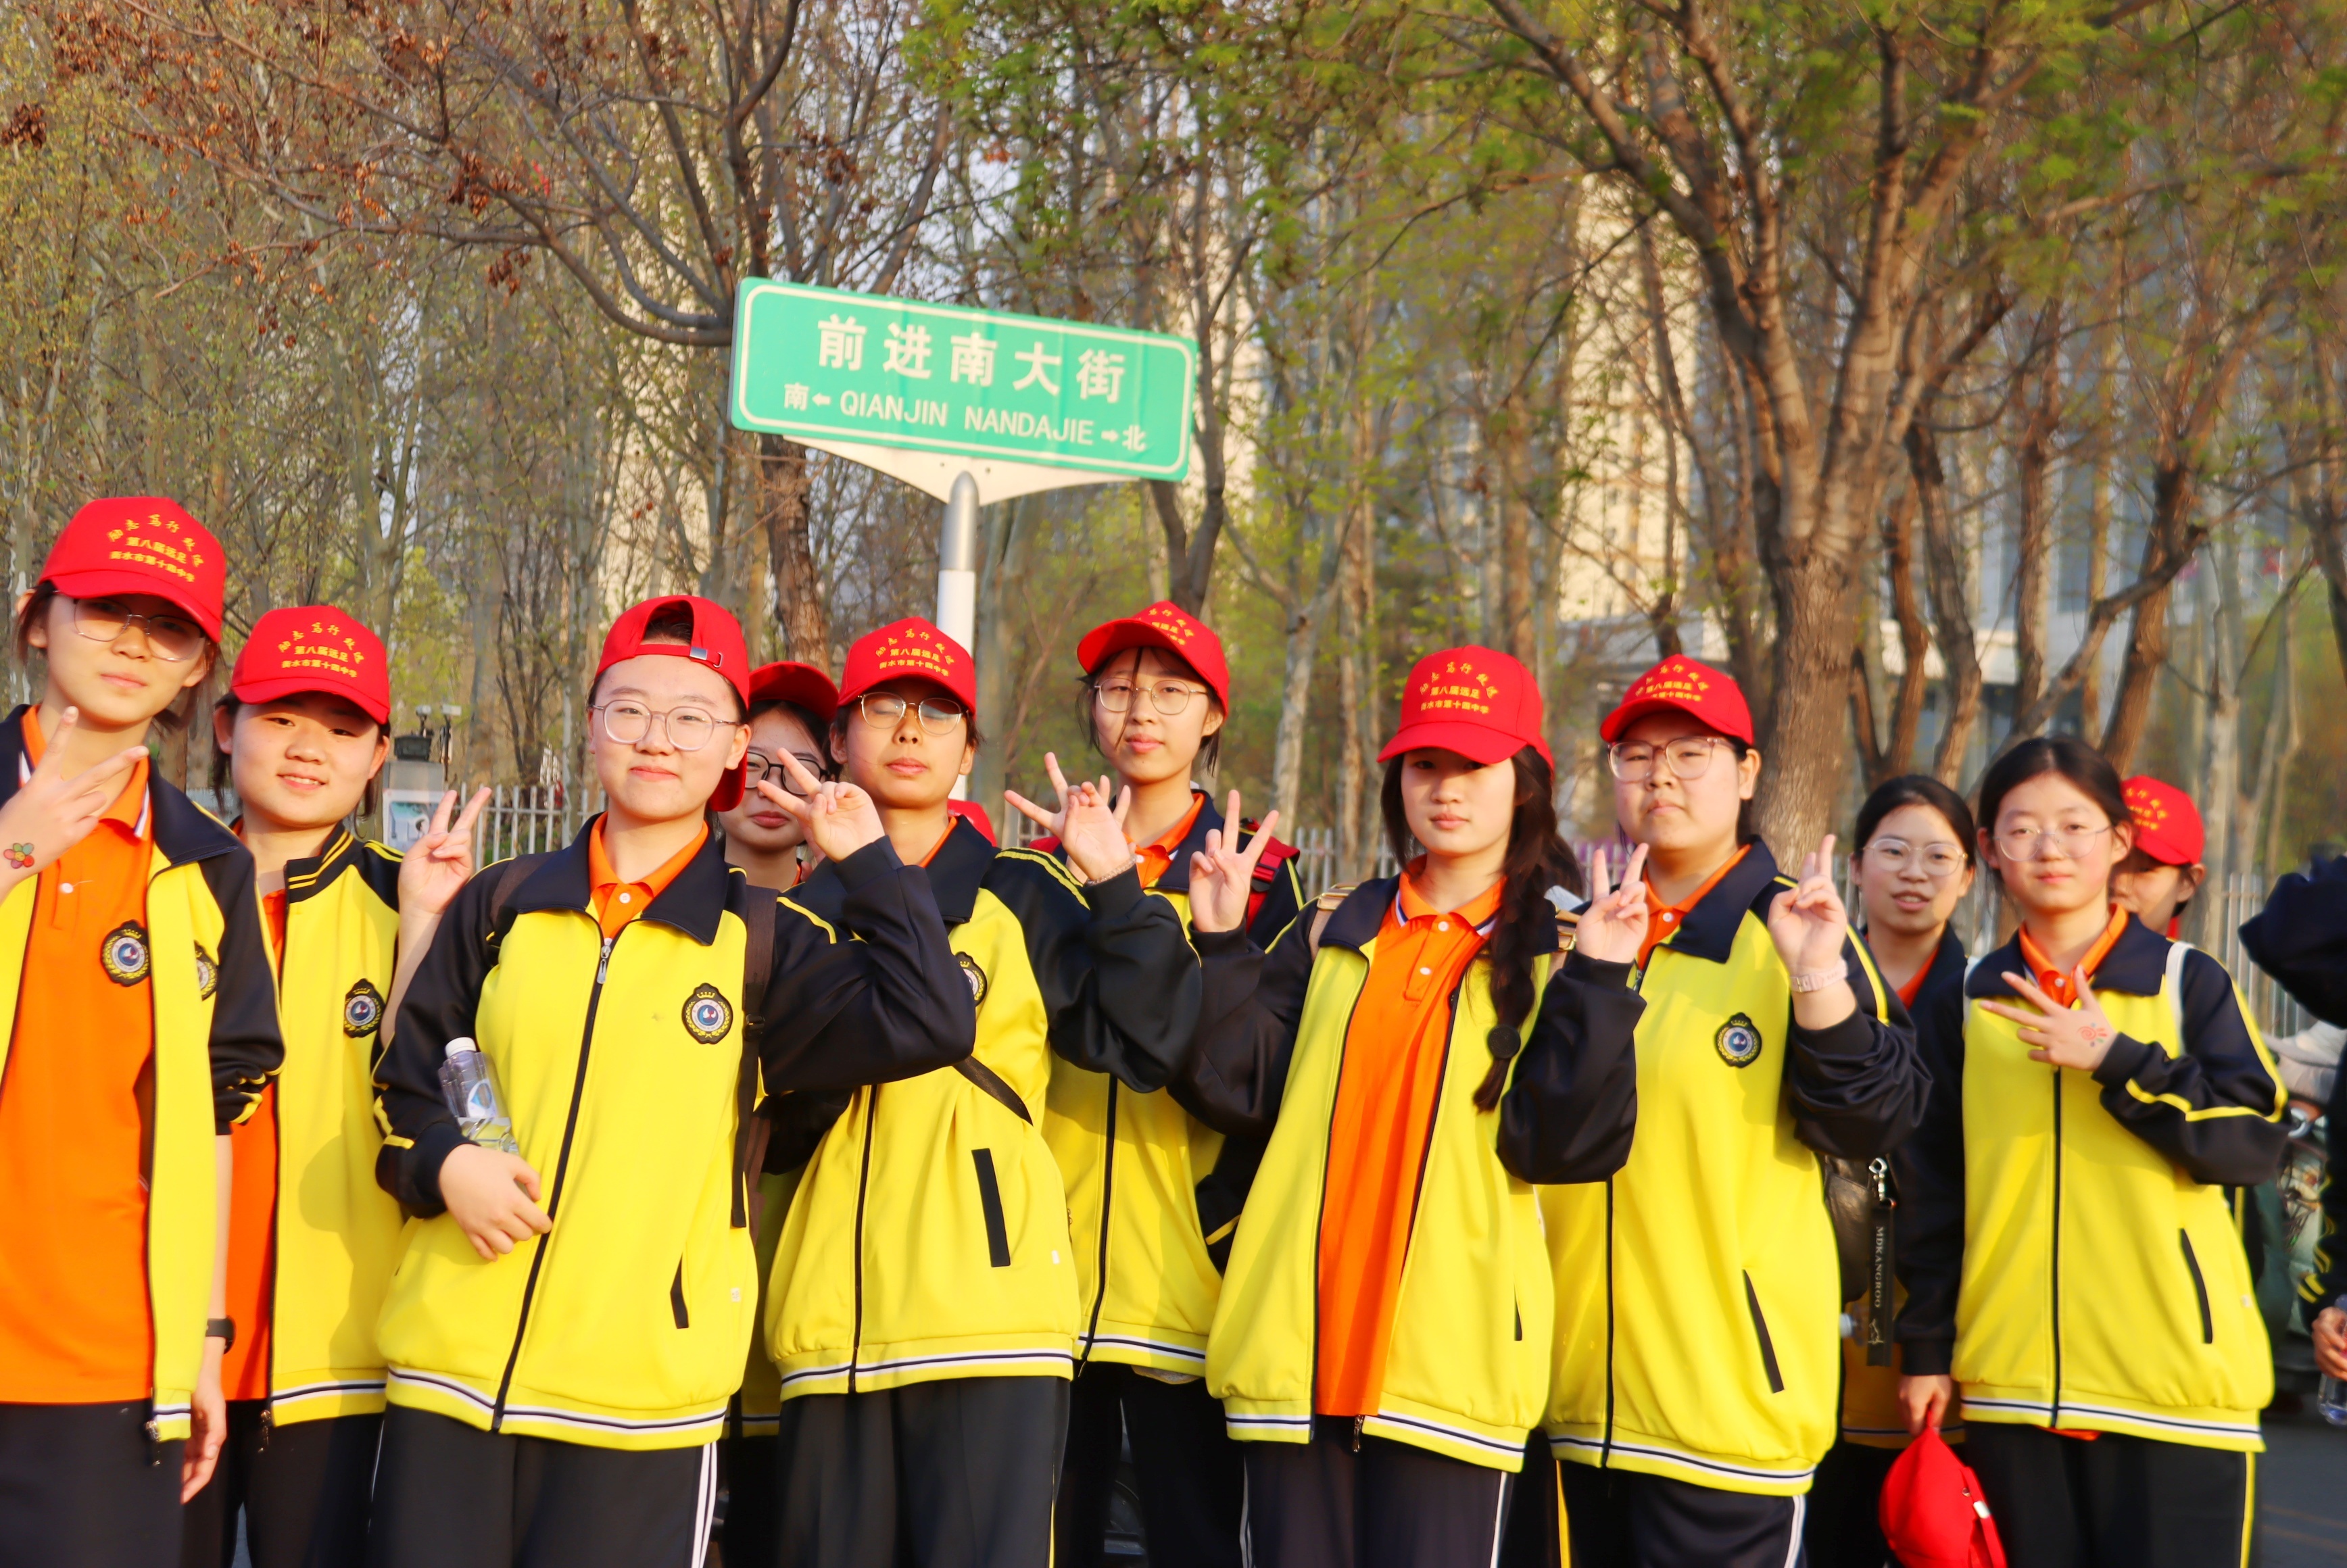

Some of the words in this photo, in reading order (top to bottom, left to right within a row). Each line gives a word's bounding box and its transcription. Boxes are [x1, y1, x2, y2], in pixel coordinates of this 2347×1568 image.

[817, 314, 1125, 403] 前进南大街
[784, 382, 810, 411] 南
[840, 390, 948, 426] QIANJIN
[964, 406, 1094, 445] NANDAJIE
[1122, 424, 1147, 452] 北
[1874, 1226, 1884, 1308] MDKANGROO
